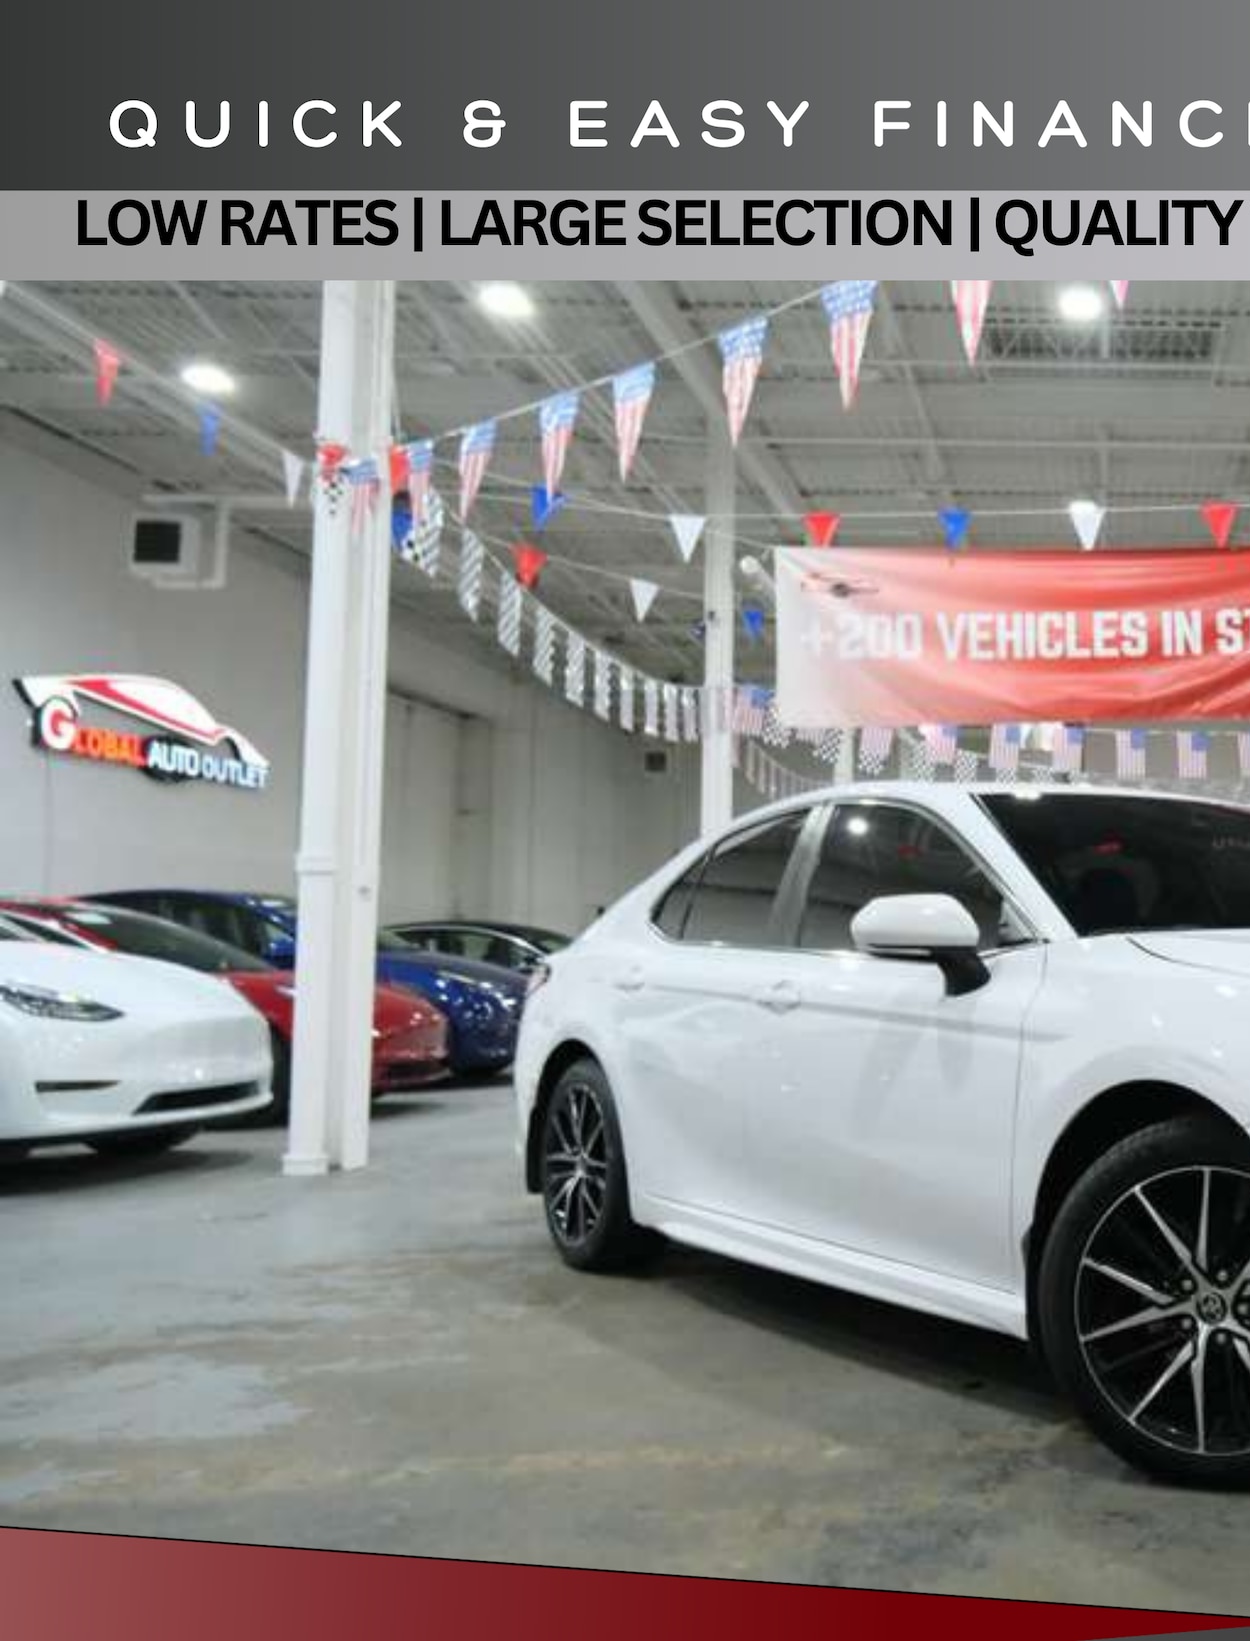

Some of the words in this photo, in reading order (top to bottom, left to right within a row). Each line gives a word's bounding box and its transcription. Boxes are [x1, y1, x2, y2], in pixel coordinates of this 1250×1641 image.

[936, 607, 1149, 660] VEHICLES
[1160, 608, 1204, 655] IN
[40, 698, 150, 768] GLOBAL
[149, 740, 200, 776] AUTO
[201, 753, 268, 789] OUTLET
